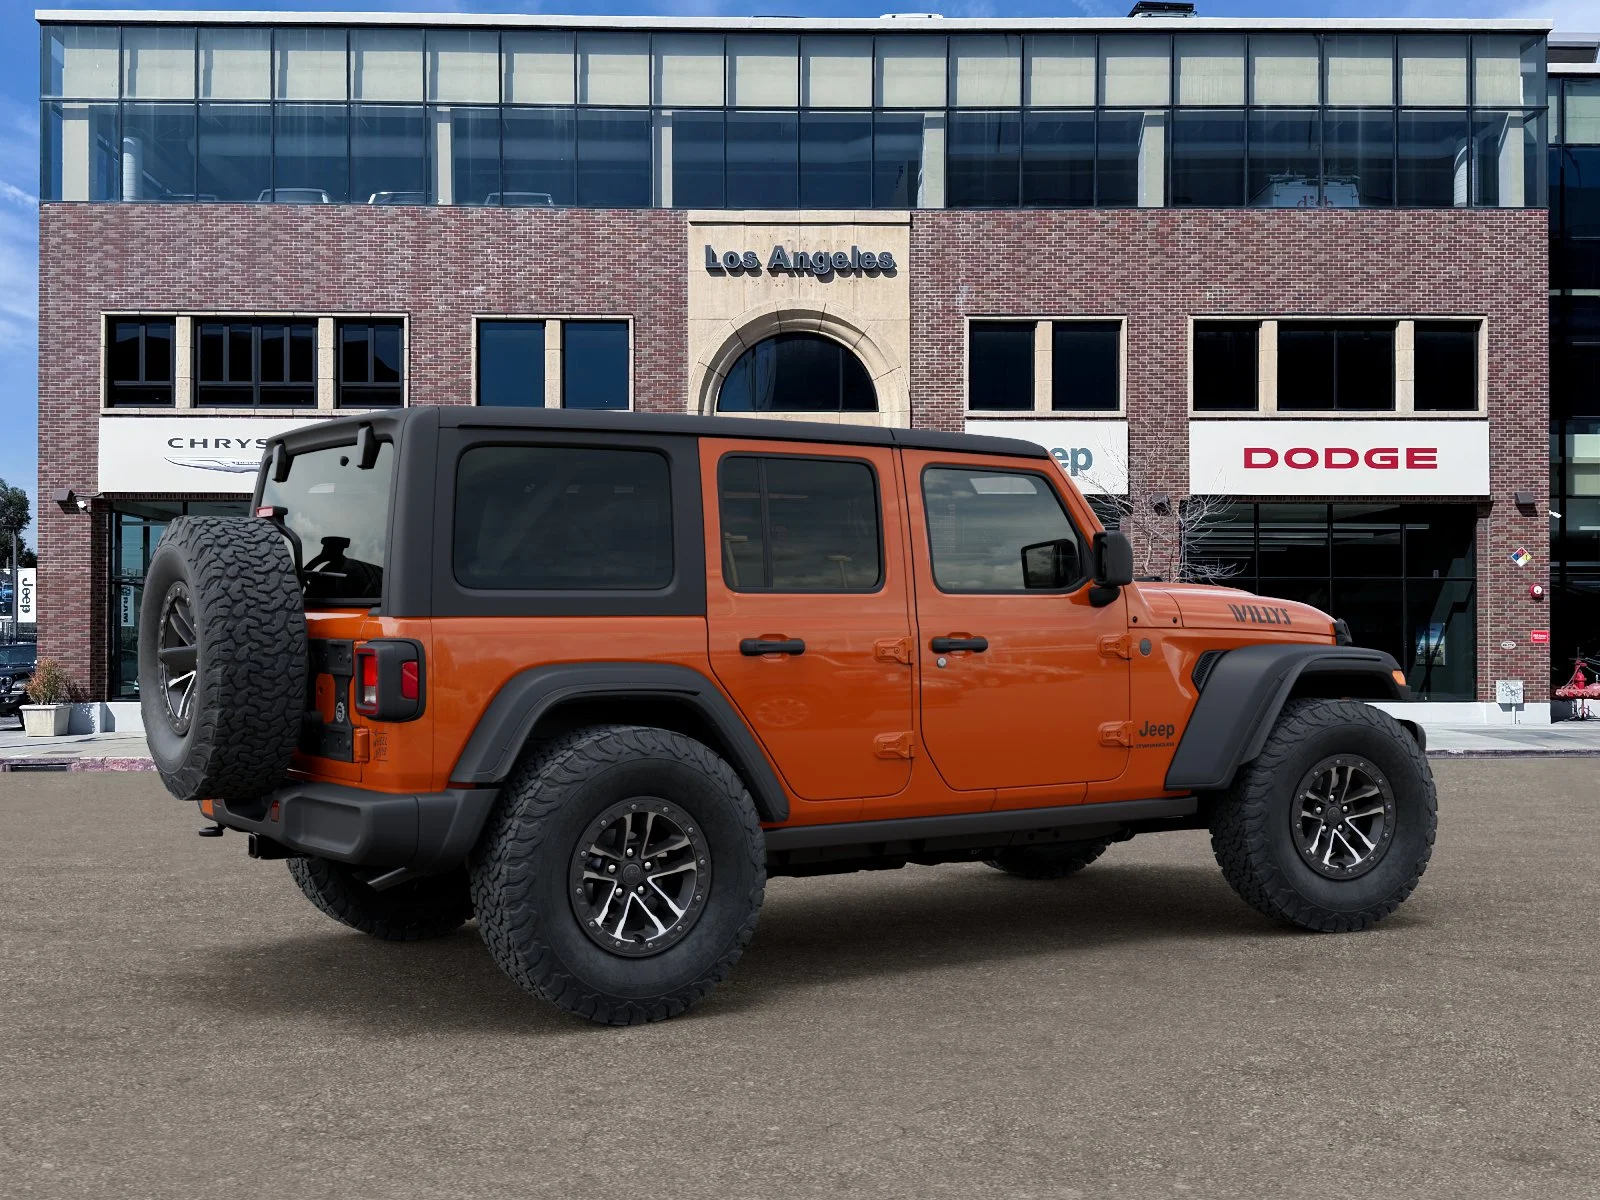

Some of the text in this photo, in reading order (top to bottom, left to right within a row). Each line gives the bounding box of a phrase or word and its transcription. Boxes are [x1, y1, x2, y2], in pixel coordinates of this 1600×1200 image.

[704, 244, 896, 275] Los Angeles
[1243, 447, 1438, 469] DODGE
[20, 577, 34, 614] Jeep
[1227, 603, 1292, 625] WILLYS
[1138, 720, 1175, 740] Jeep
